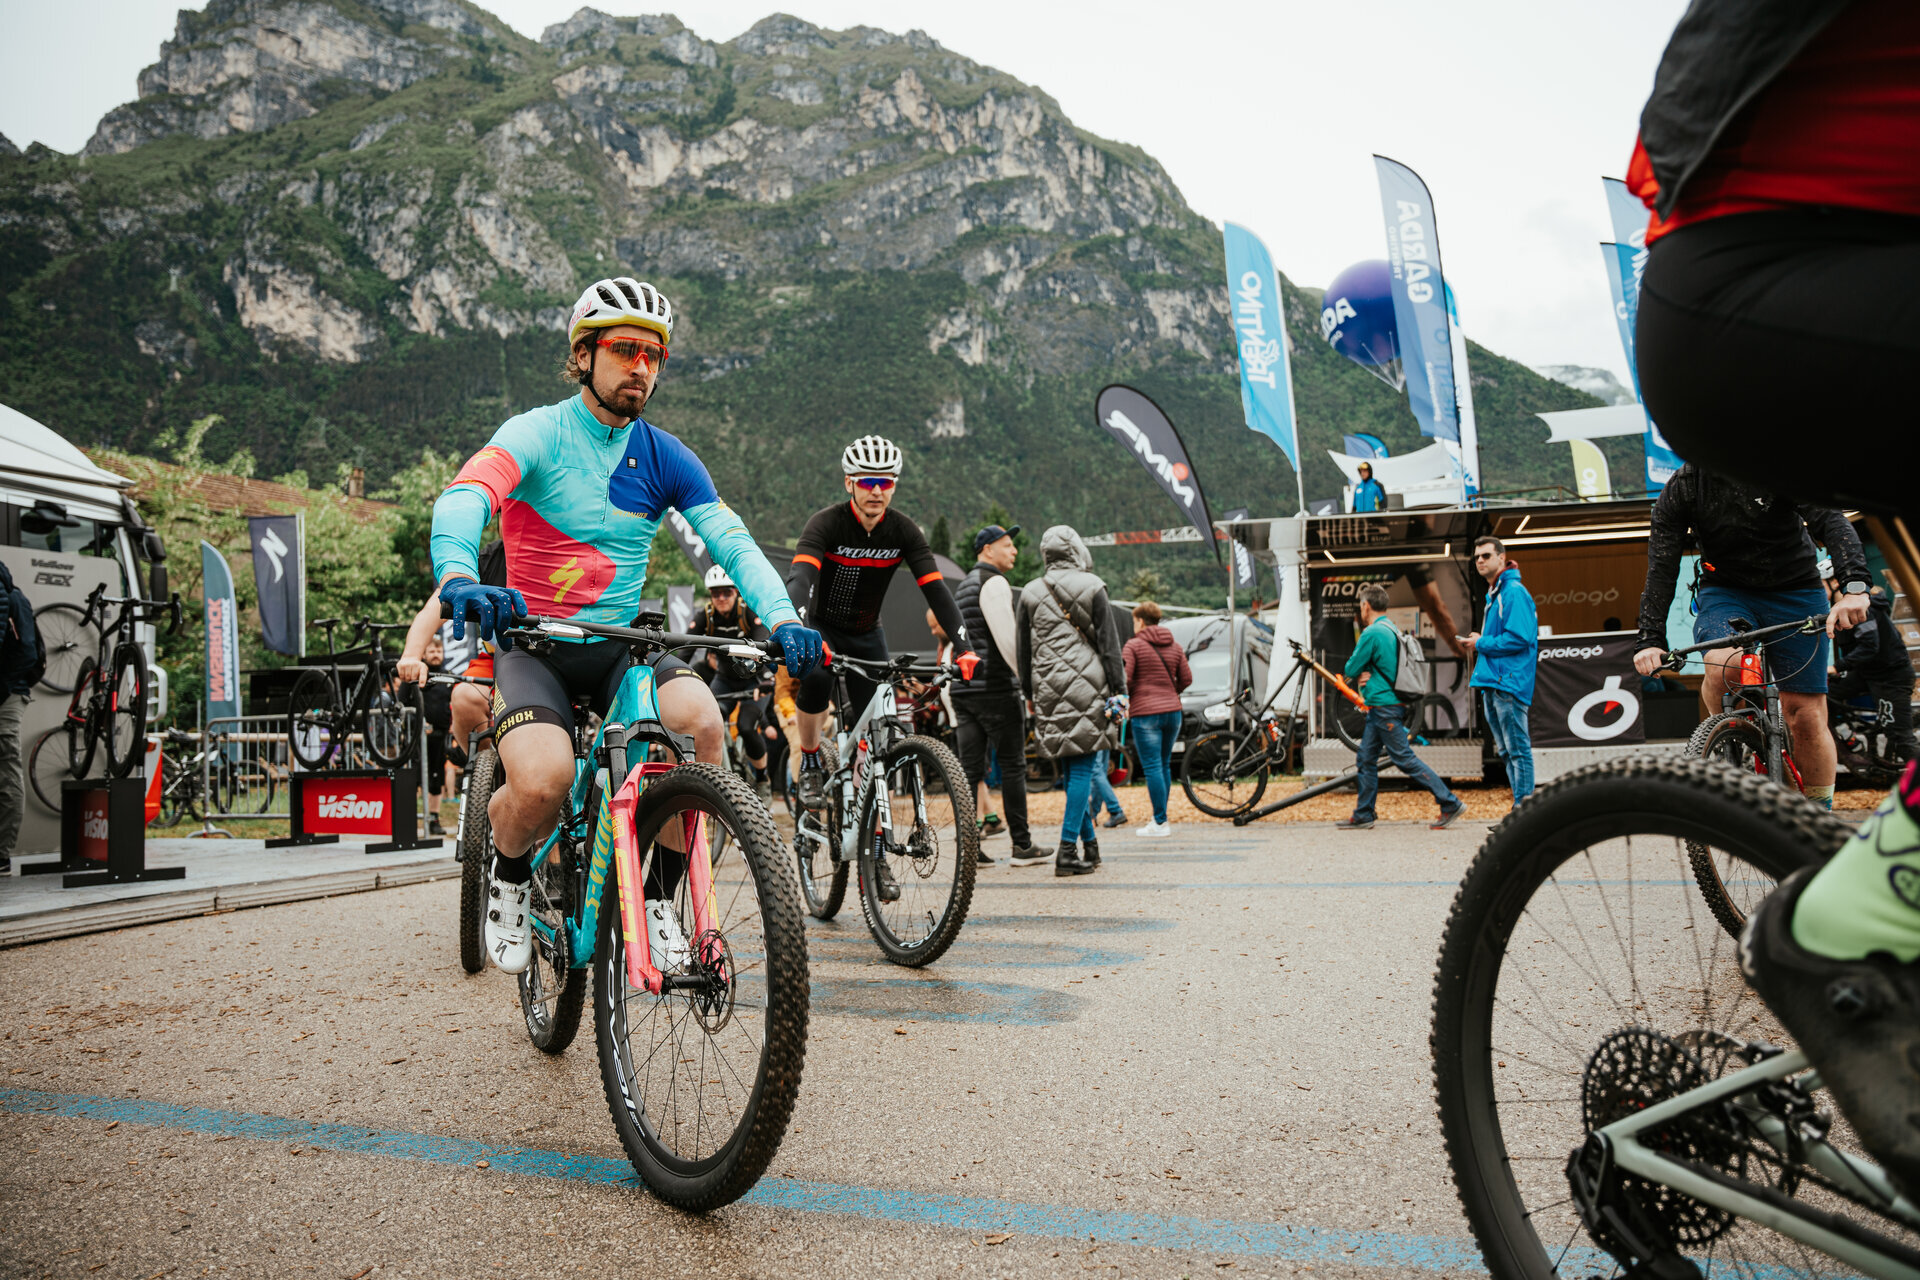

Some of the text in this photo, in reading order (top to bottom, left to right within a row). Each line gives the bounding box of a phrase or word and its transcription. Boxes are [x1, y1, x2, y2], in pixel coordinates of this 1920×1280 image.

[834, 545, 901, 559] SPECIALIZED
[318, 793, 384, 819] Vision
[84, 810, 108, 840] Visio
[586, 768, 612, 919] S-WOR
